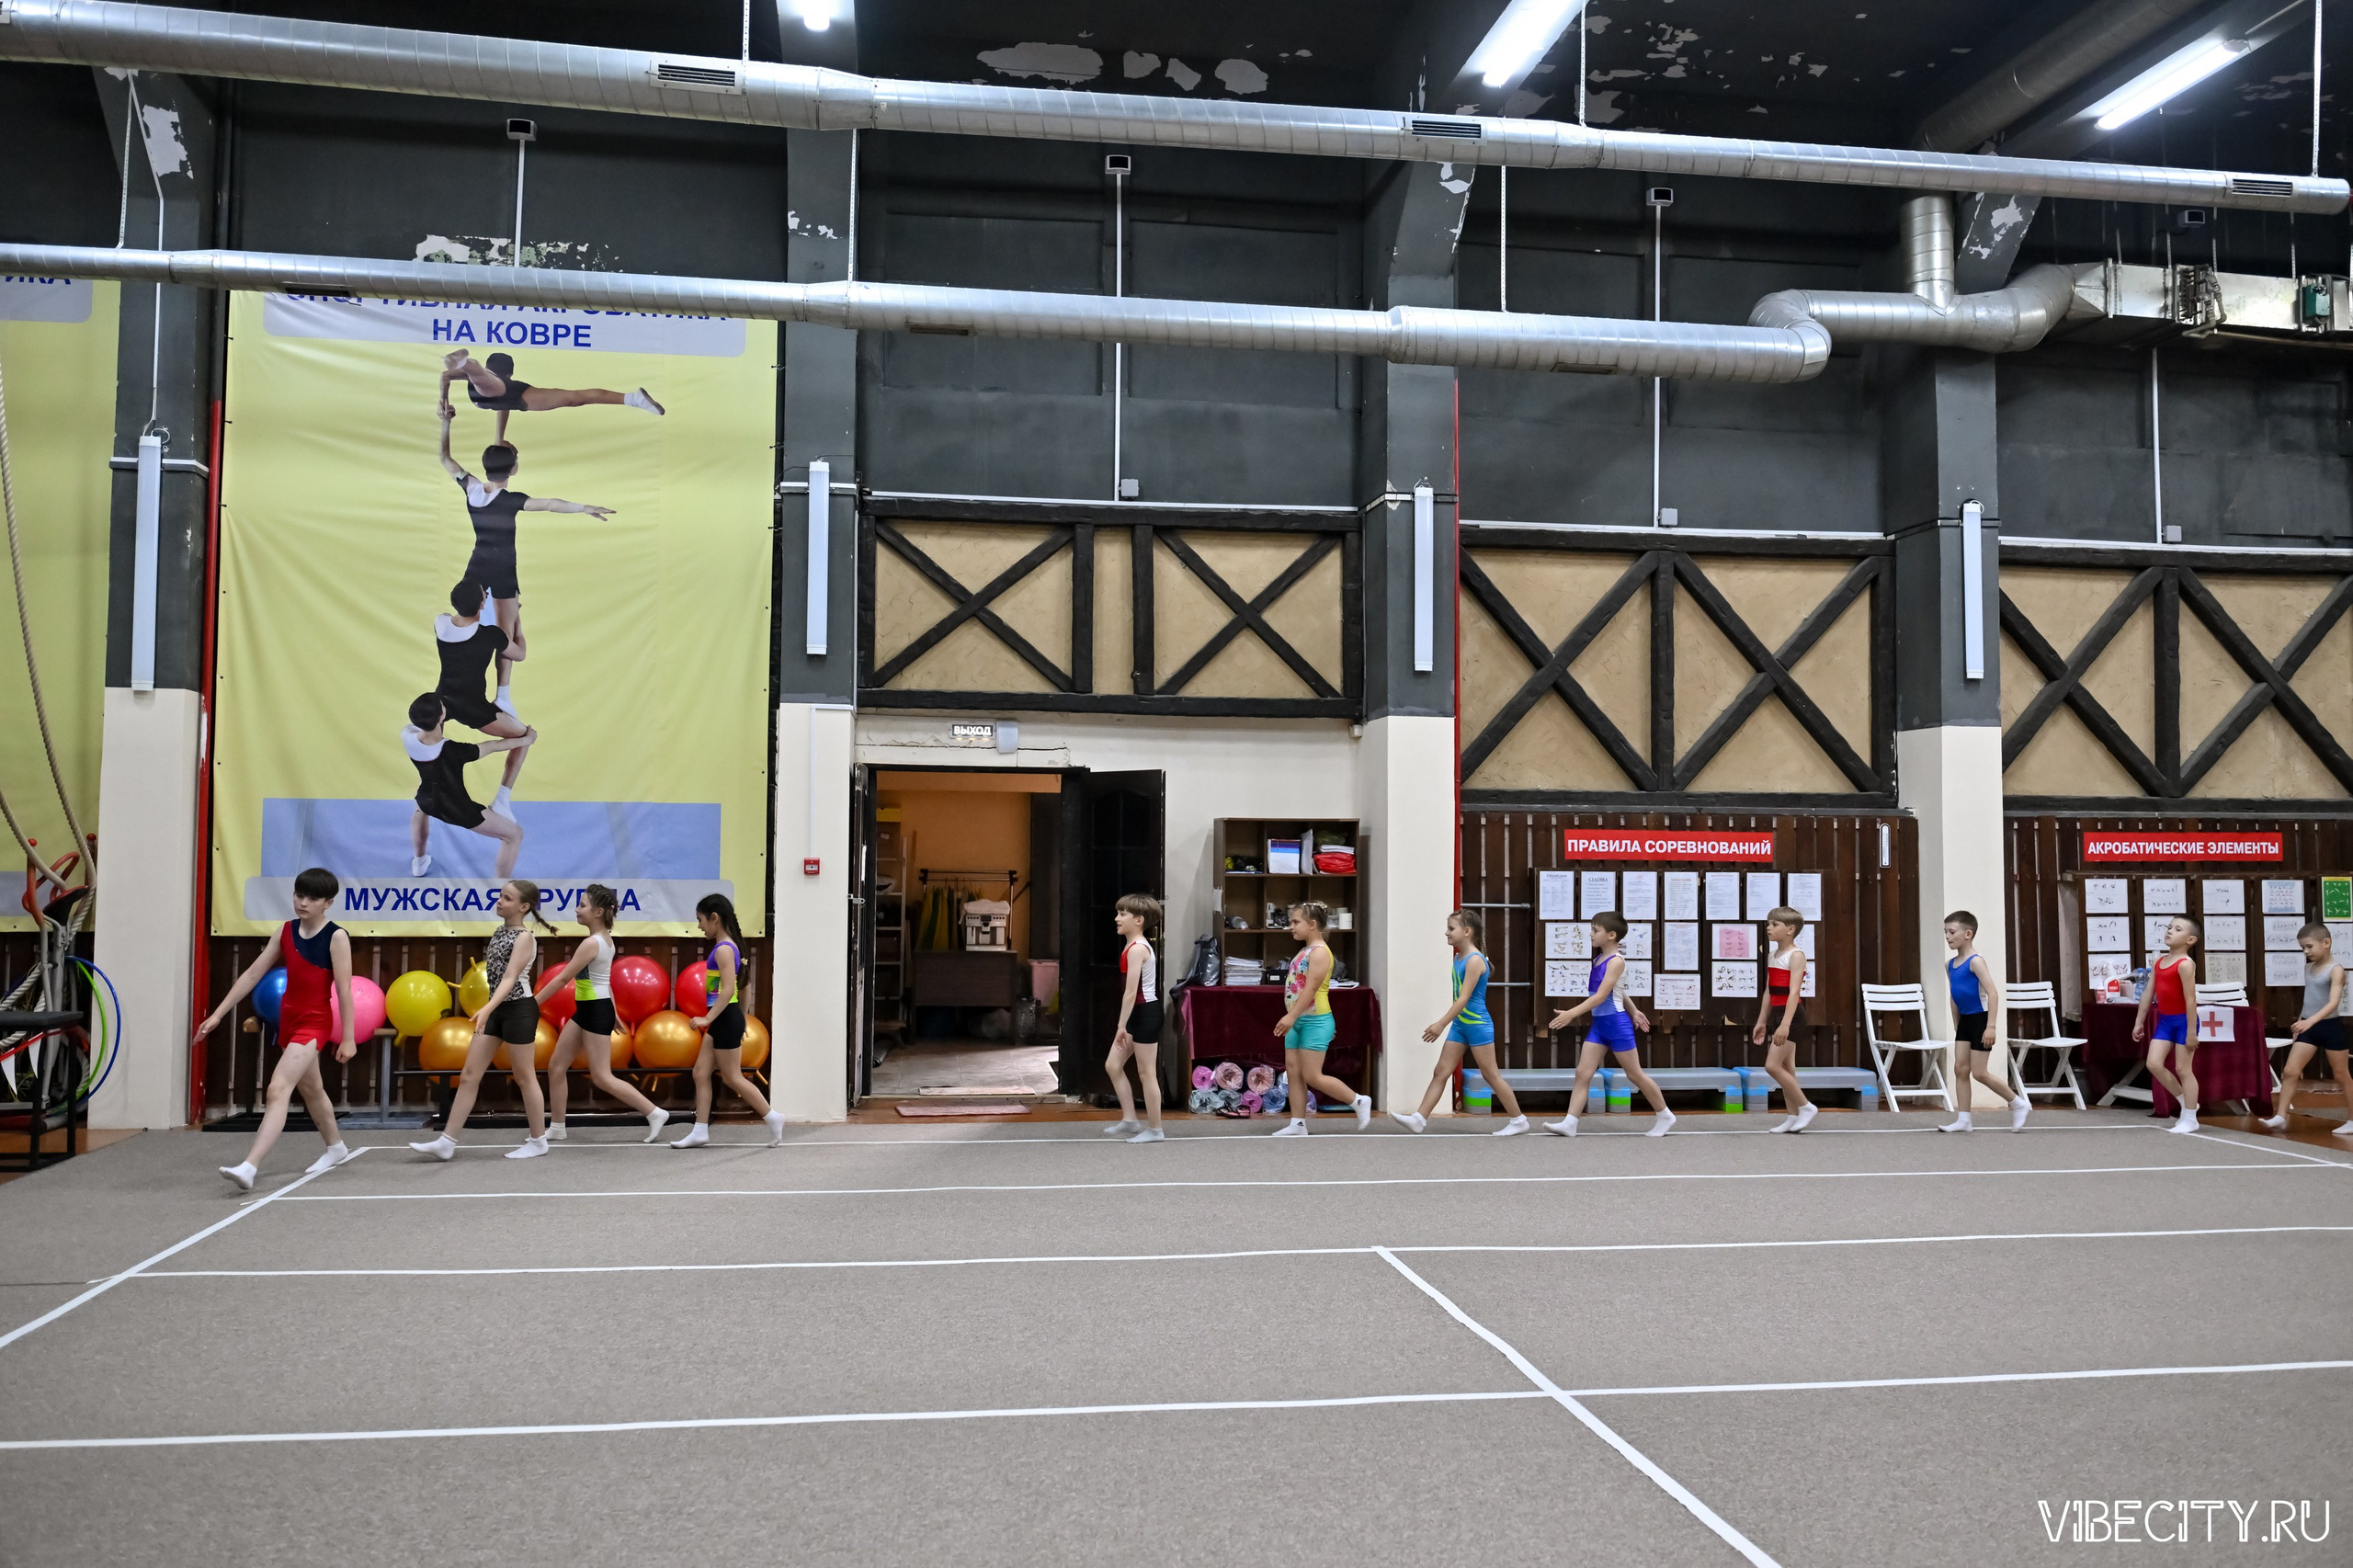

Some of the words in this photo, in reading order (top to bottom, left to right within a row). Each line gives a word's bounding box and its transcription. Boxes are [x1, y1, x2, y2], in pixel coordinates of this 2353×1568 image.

[432, 318, 476, 343] НА
[486, 320, 592, 347] КОВРЕ
[954, 725, 991, 735] ВЫХОД
[1567, 838, 1642, 854] ПРАВИЛА
[1644, 839, 1772, 856] СОРЕВНОВАНИЙ
[2087, 841, 2205, 855] АКРОБАТИЧЕСКИЕ
[2207, 841, 2279, 855] ЭЛЕМЕНТЫ
[345, 887, 503, 912] МУЖСКАЯ
